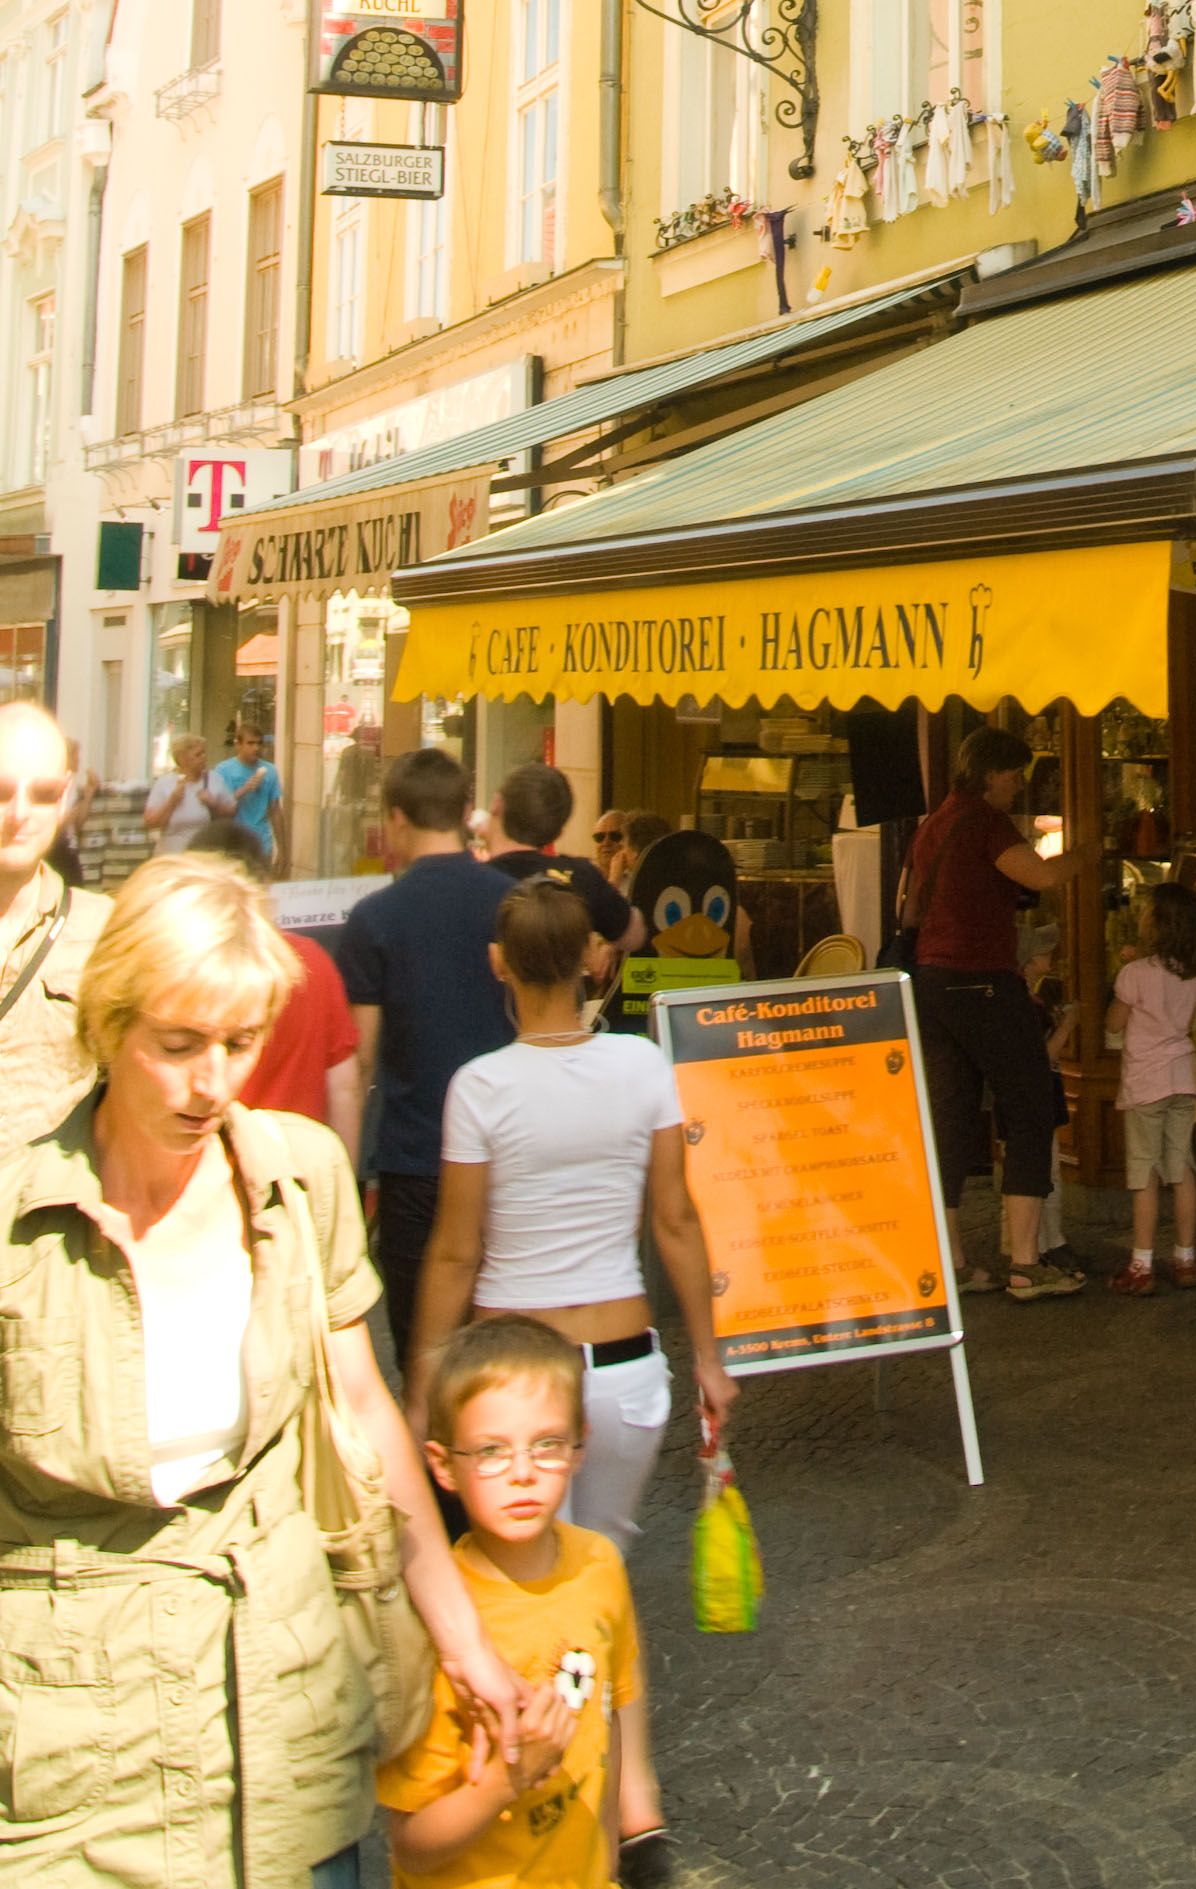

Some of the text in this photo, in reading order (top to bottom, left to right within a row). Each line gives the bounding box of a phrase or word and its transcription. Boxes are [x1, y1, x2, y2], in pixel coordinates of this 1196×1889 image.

[335, 151, 433, 186] SALZBURGER STIEGL-BIER
[188, 460, 246, 533] T
[486, 625, 539, 676] CAFE
[562, 614, 727, 674] KONDITOREI
[758, 601, 950, 672] HAGMANN
[696, 988, 878, 1027] Café-Konditorei
[737, 1022, 845, 1051] Hagmann
[811, 1123, 849, 1138] TOAST
